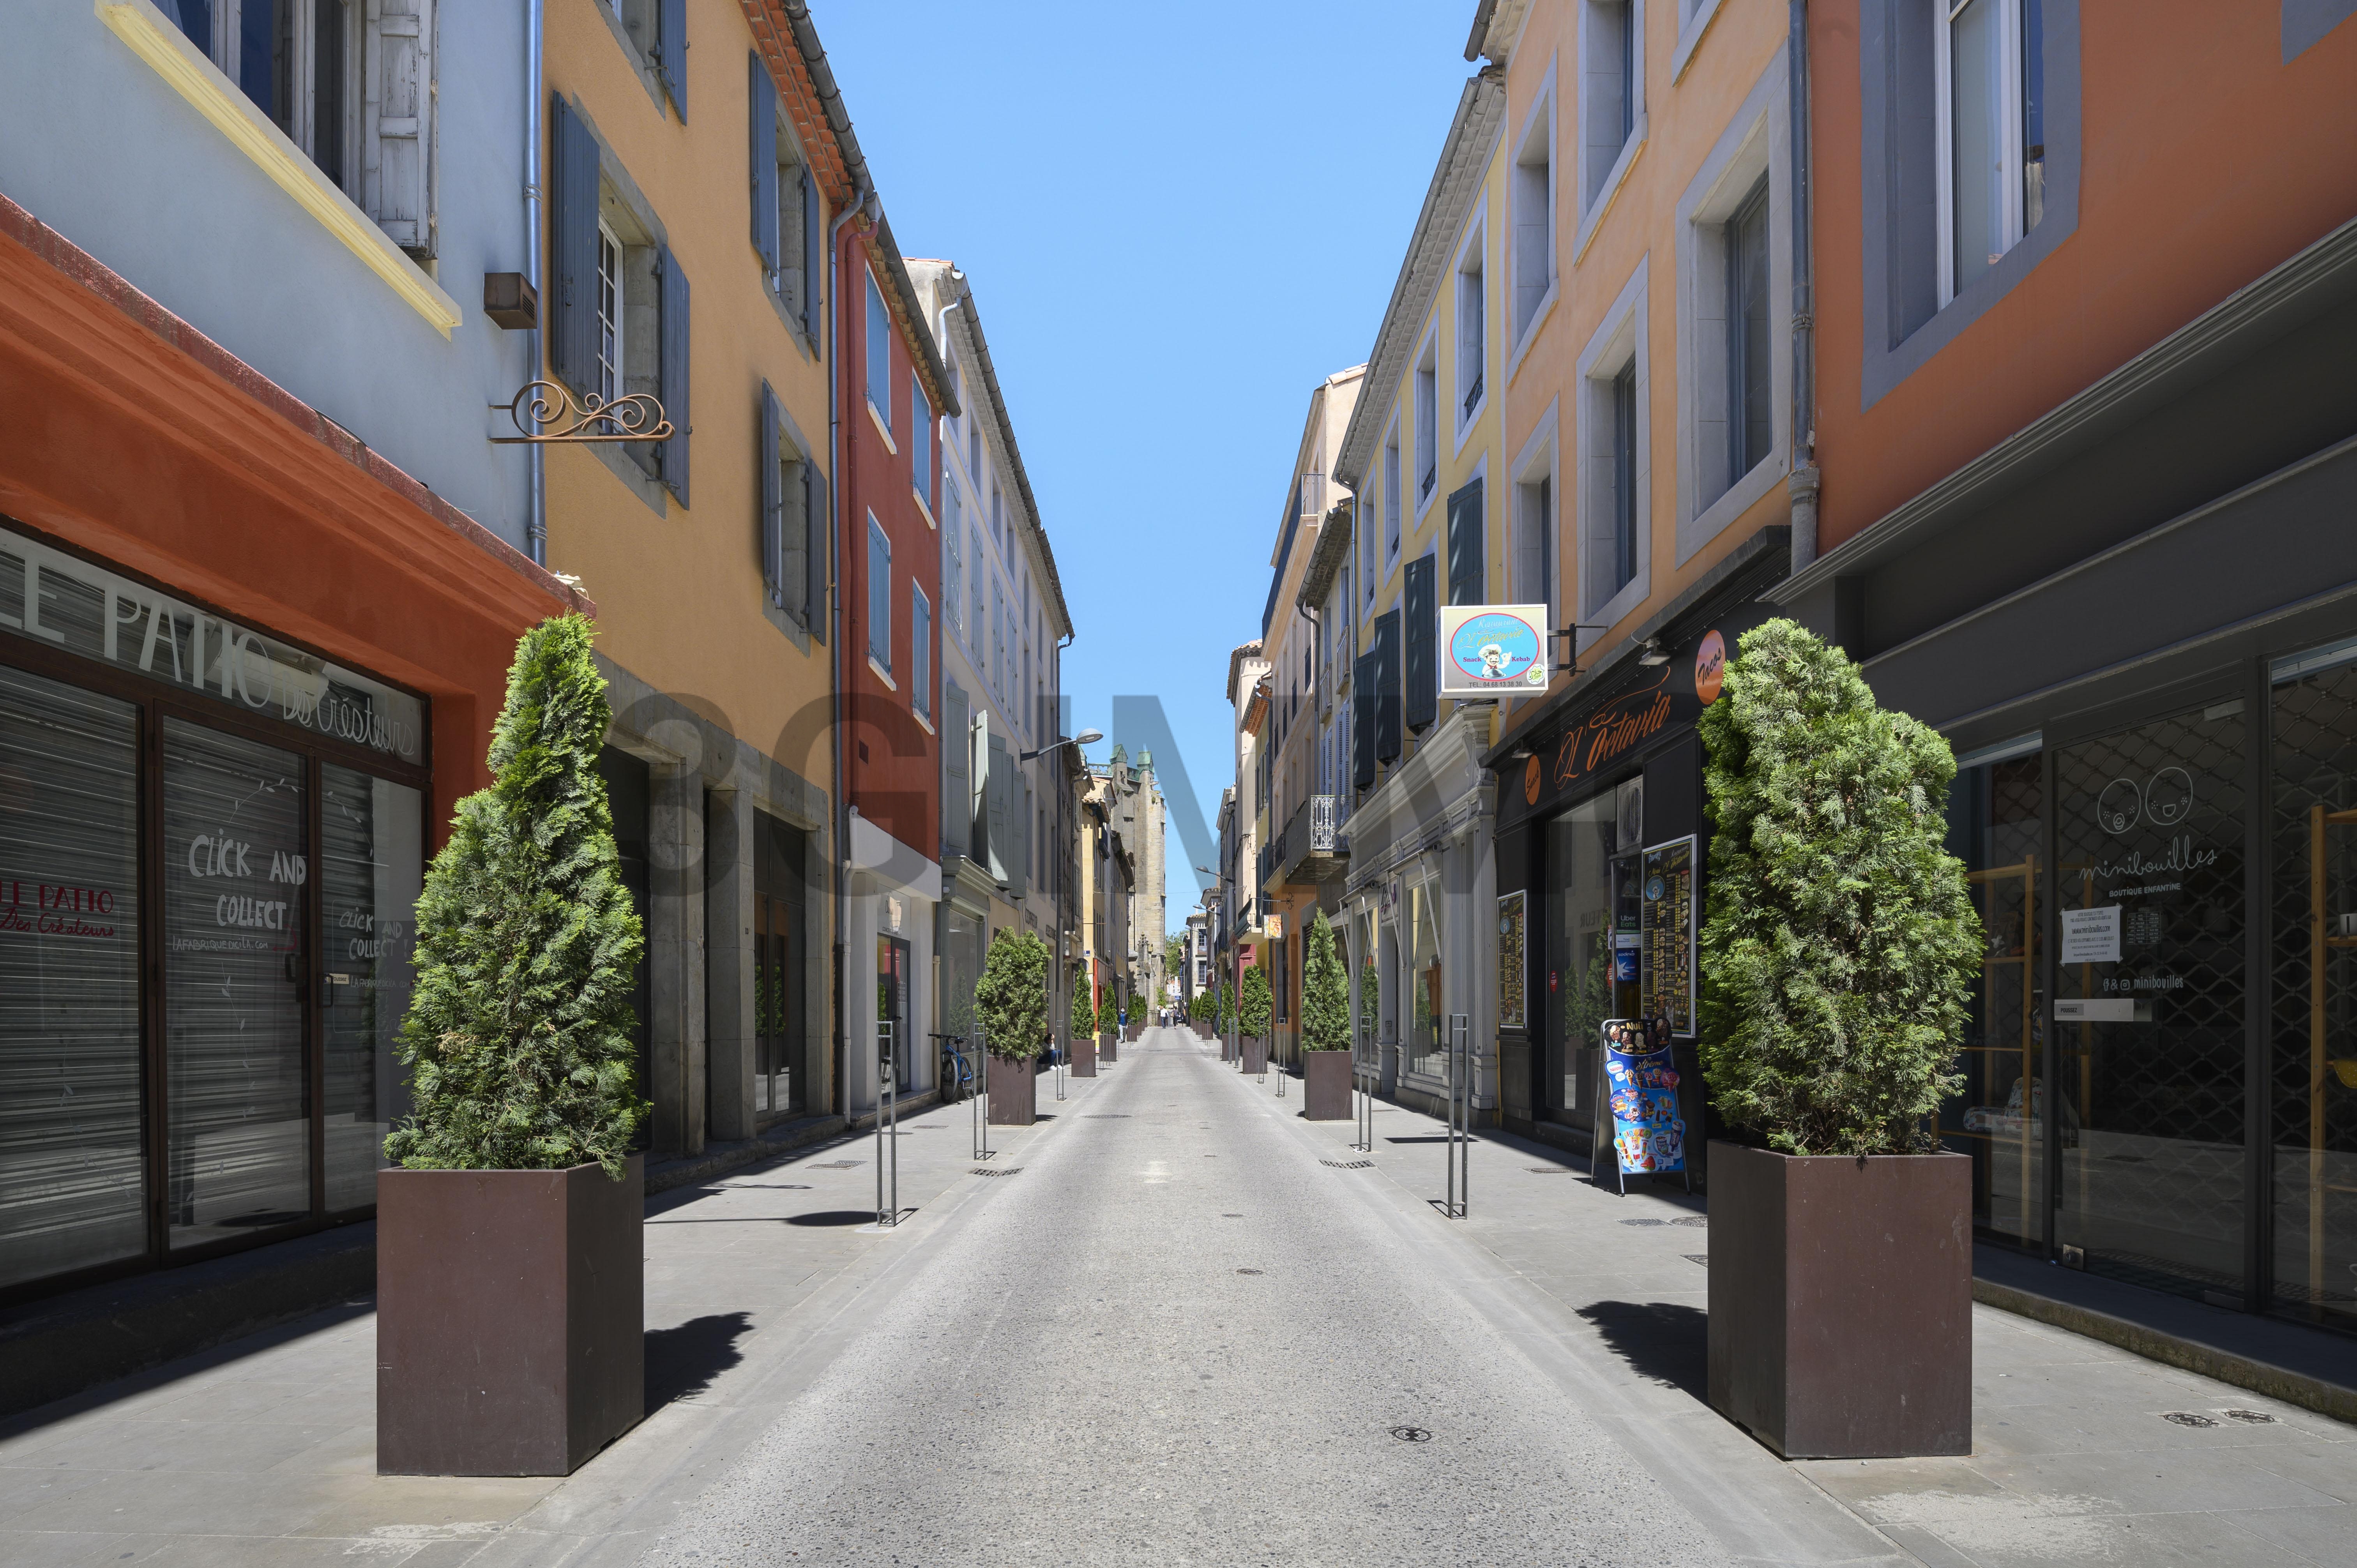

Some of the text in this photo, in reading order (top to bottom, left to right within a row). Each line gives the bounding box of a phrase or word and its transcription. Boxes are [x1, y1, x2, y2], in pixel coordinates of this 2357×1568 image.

[104, 581, 272, 708] PATIO
[1698, 647, 1722, 685] Tacos
[1527, 764, 1539, 795] Snack
[188, 828, 306, 886] CLICK AND
[2079, 835, 2217, 880] minibouilles
[39, 884, 113, 914] PATIO
[2109, 882, 2181, 897] BOUTIQUE ENFANTINE
[0, 907, 114, 937] Des Créateurs
[217, 894, 287, 930] COLLECT
[339, 907, 403, 938] CLICK AND
[2072, 924, 2111, 934] www.minibouilles.com
[349, 938, 396, 960] COLLECT
[2134, 974, 2184, 990] minibouilles
